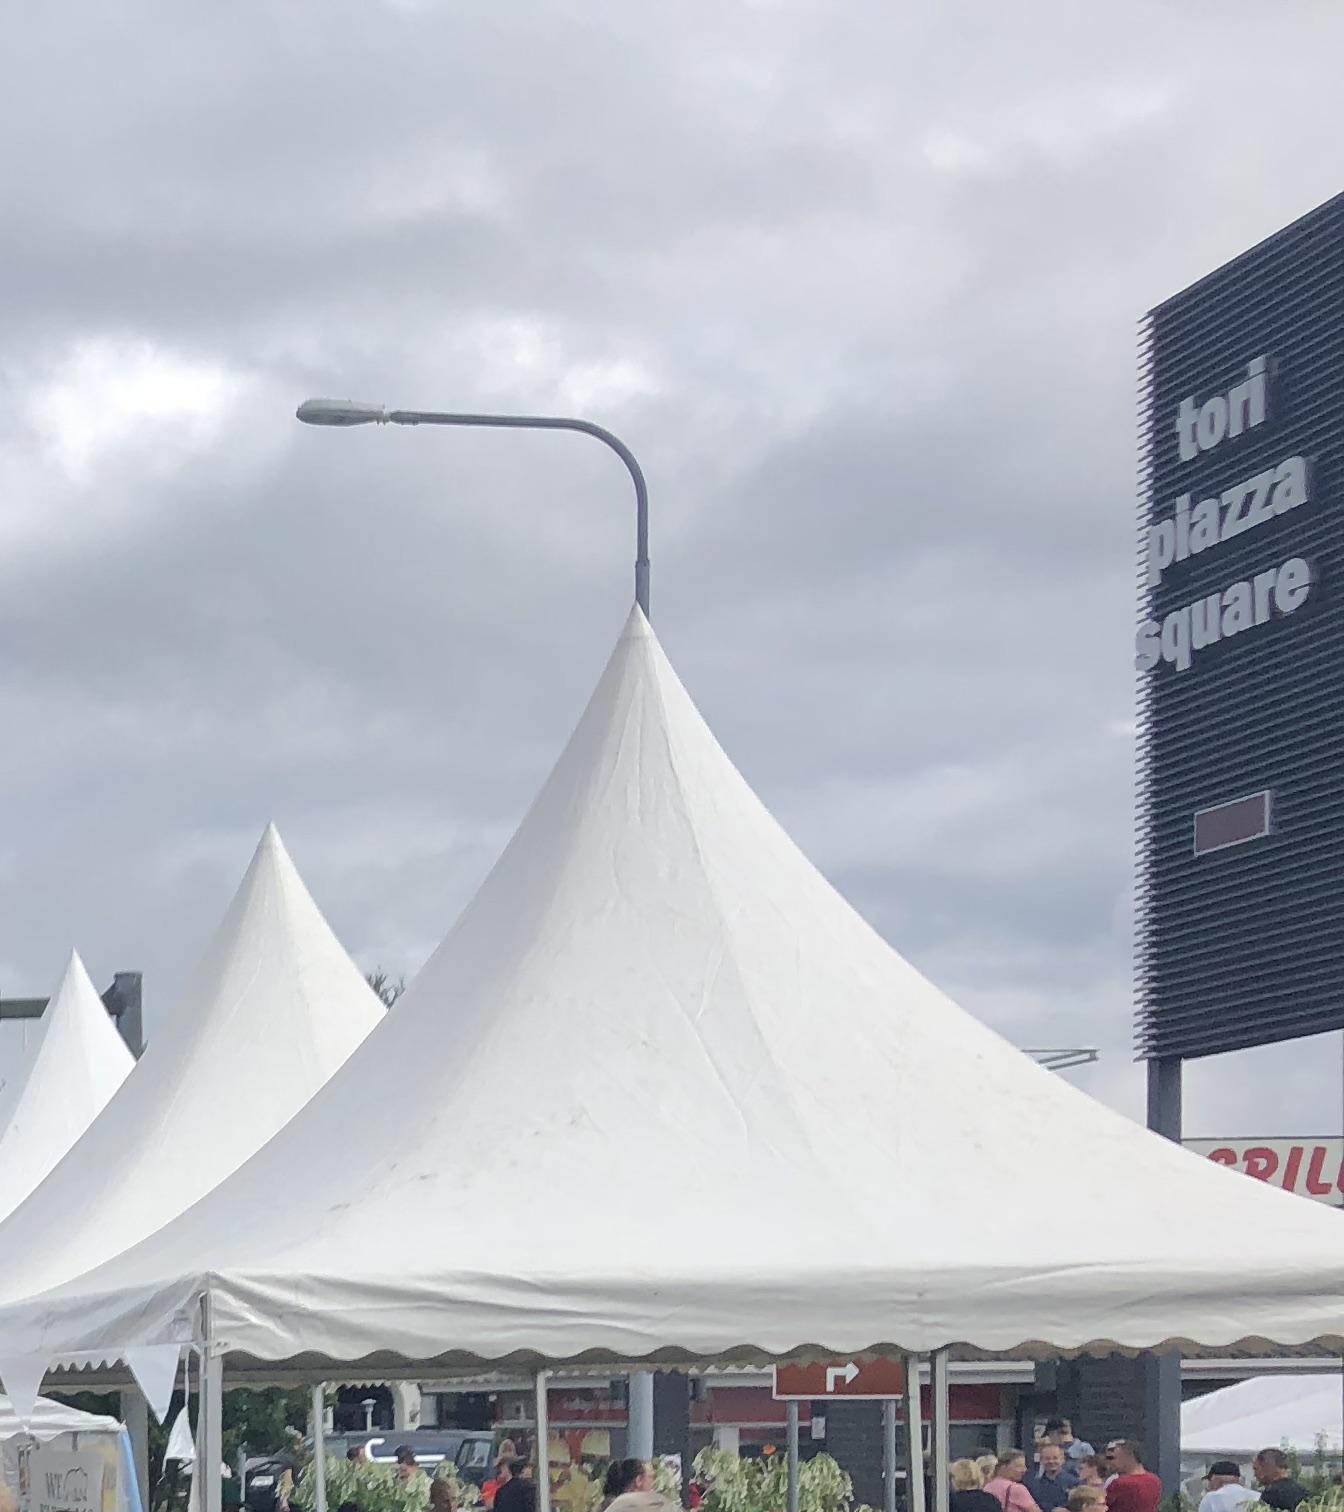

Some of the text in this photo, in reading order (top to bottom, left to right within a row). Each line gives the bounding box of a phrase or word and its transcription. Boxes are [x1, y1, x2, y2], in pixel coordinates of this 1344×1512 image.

[1176, 355, 1267, 461] tori
[1148, 456, 1307, 586] piazza
[1135, 558, 1309, 672] square
[1207, 1146, 1344, 1195] RIL
